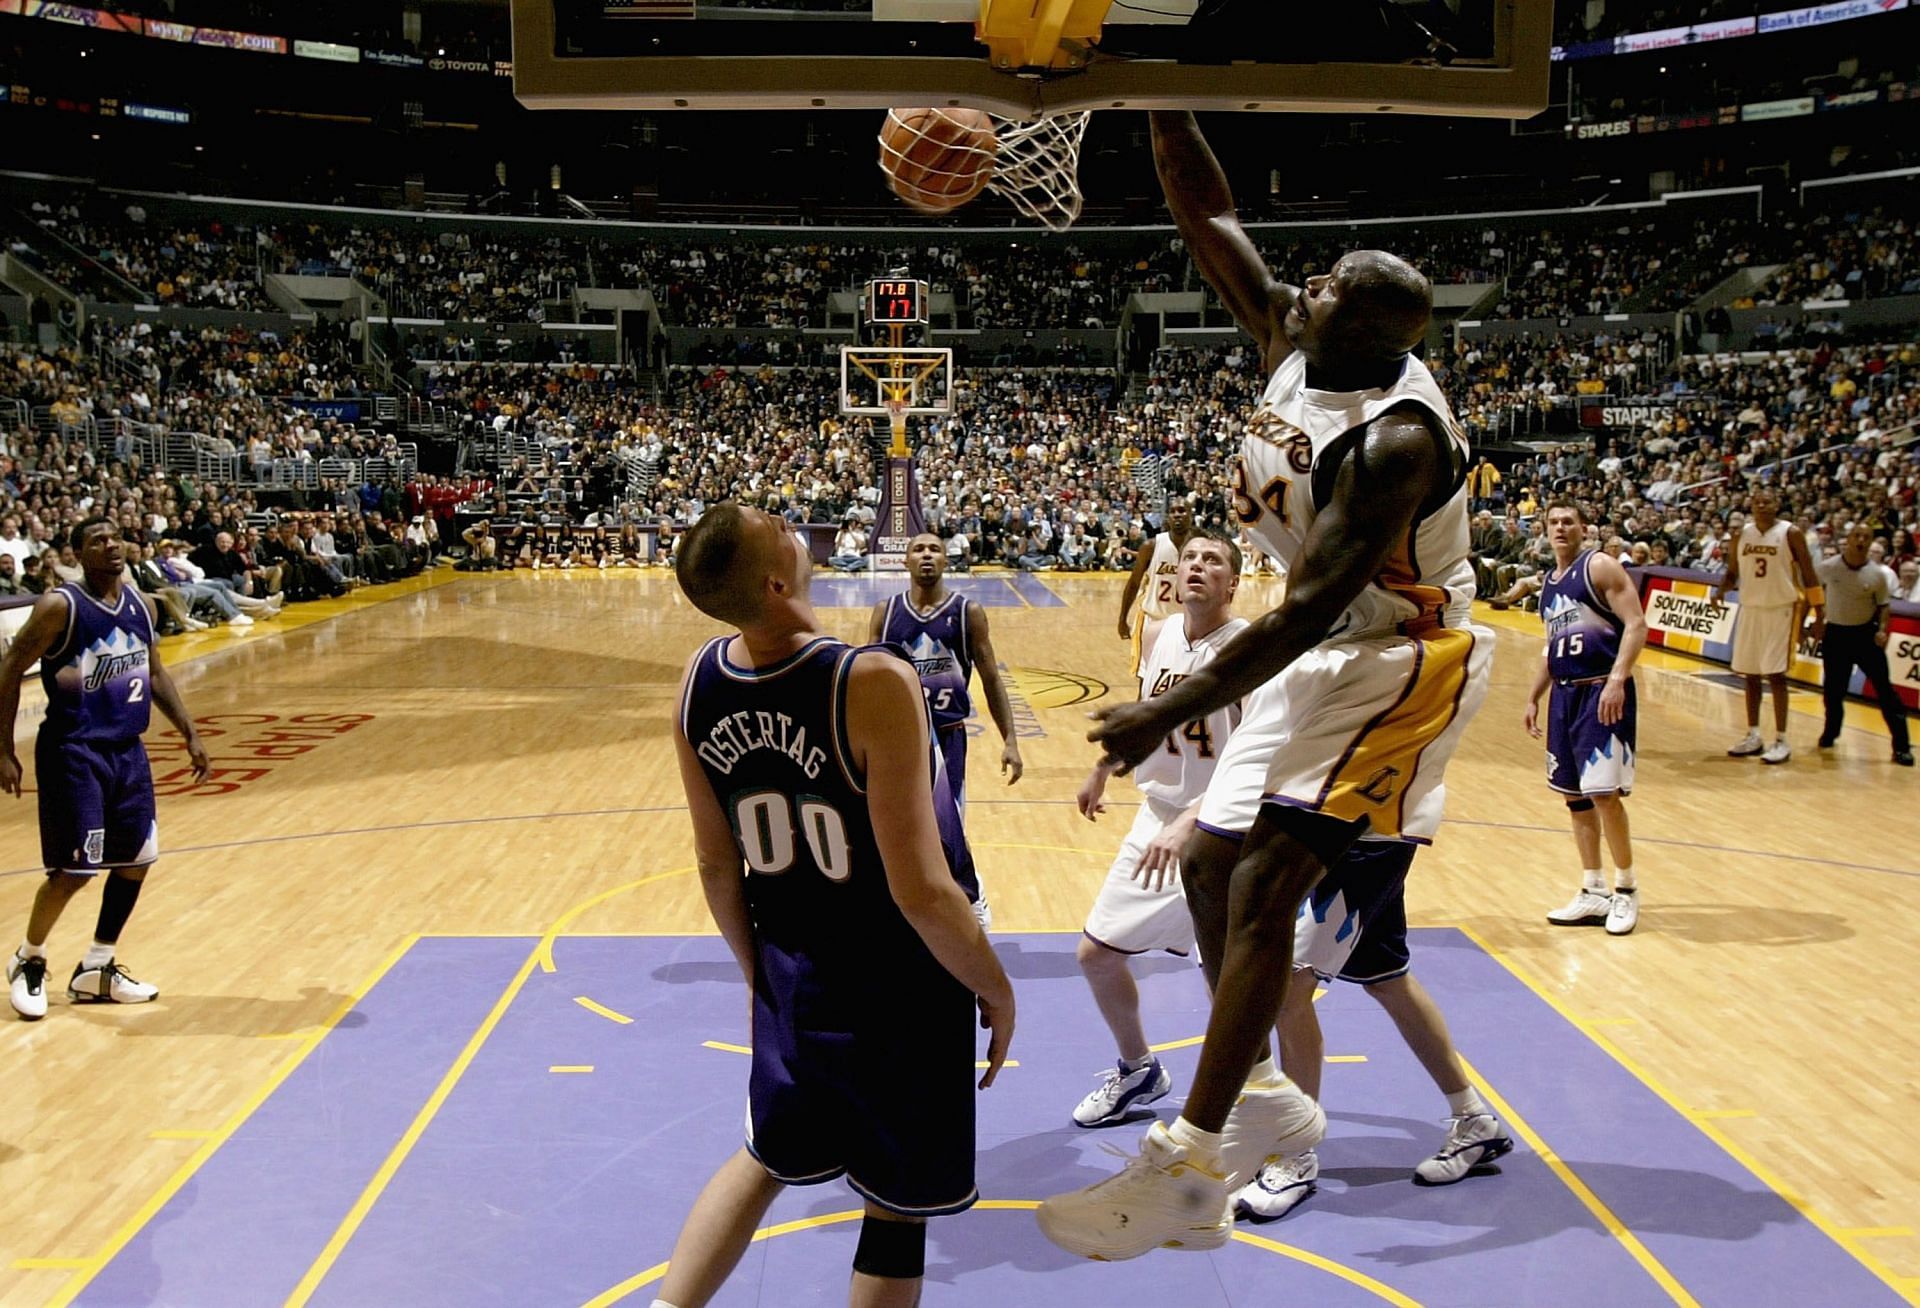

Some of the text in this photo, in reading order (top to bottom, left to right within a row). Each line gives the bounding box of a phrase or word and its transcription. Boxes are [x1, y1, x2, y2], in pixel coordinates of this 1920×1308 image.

[1759, 3, 1869, 30] Bank of America
[447, 60, 489, 72] TOYOTA
[1577, 121, 1631, 139] STAPLES
[879, 283, 907, 296] 17.8
[889, 299, 911, 318] 17
[1233, 455, 1294, 528] 34
[1156, 561, 1178, 576] LAK
[1754, 557, 1768, 578] 3
[1653, 595, 1730, 622] SOUTHWEST
[1658, 612, 1714, 636] AIRLINES
[1556, 632, 1584, 658] 15
[127, 677, 145, 703] 2
[697, 710, 827, 780] OSTERTAG
[1166, 717, 1215, 759] 14
[732, 790, 852, 883] 00
